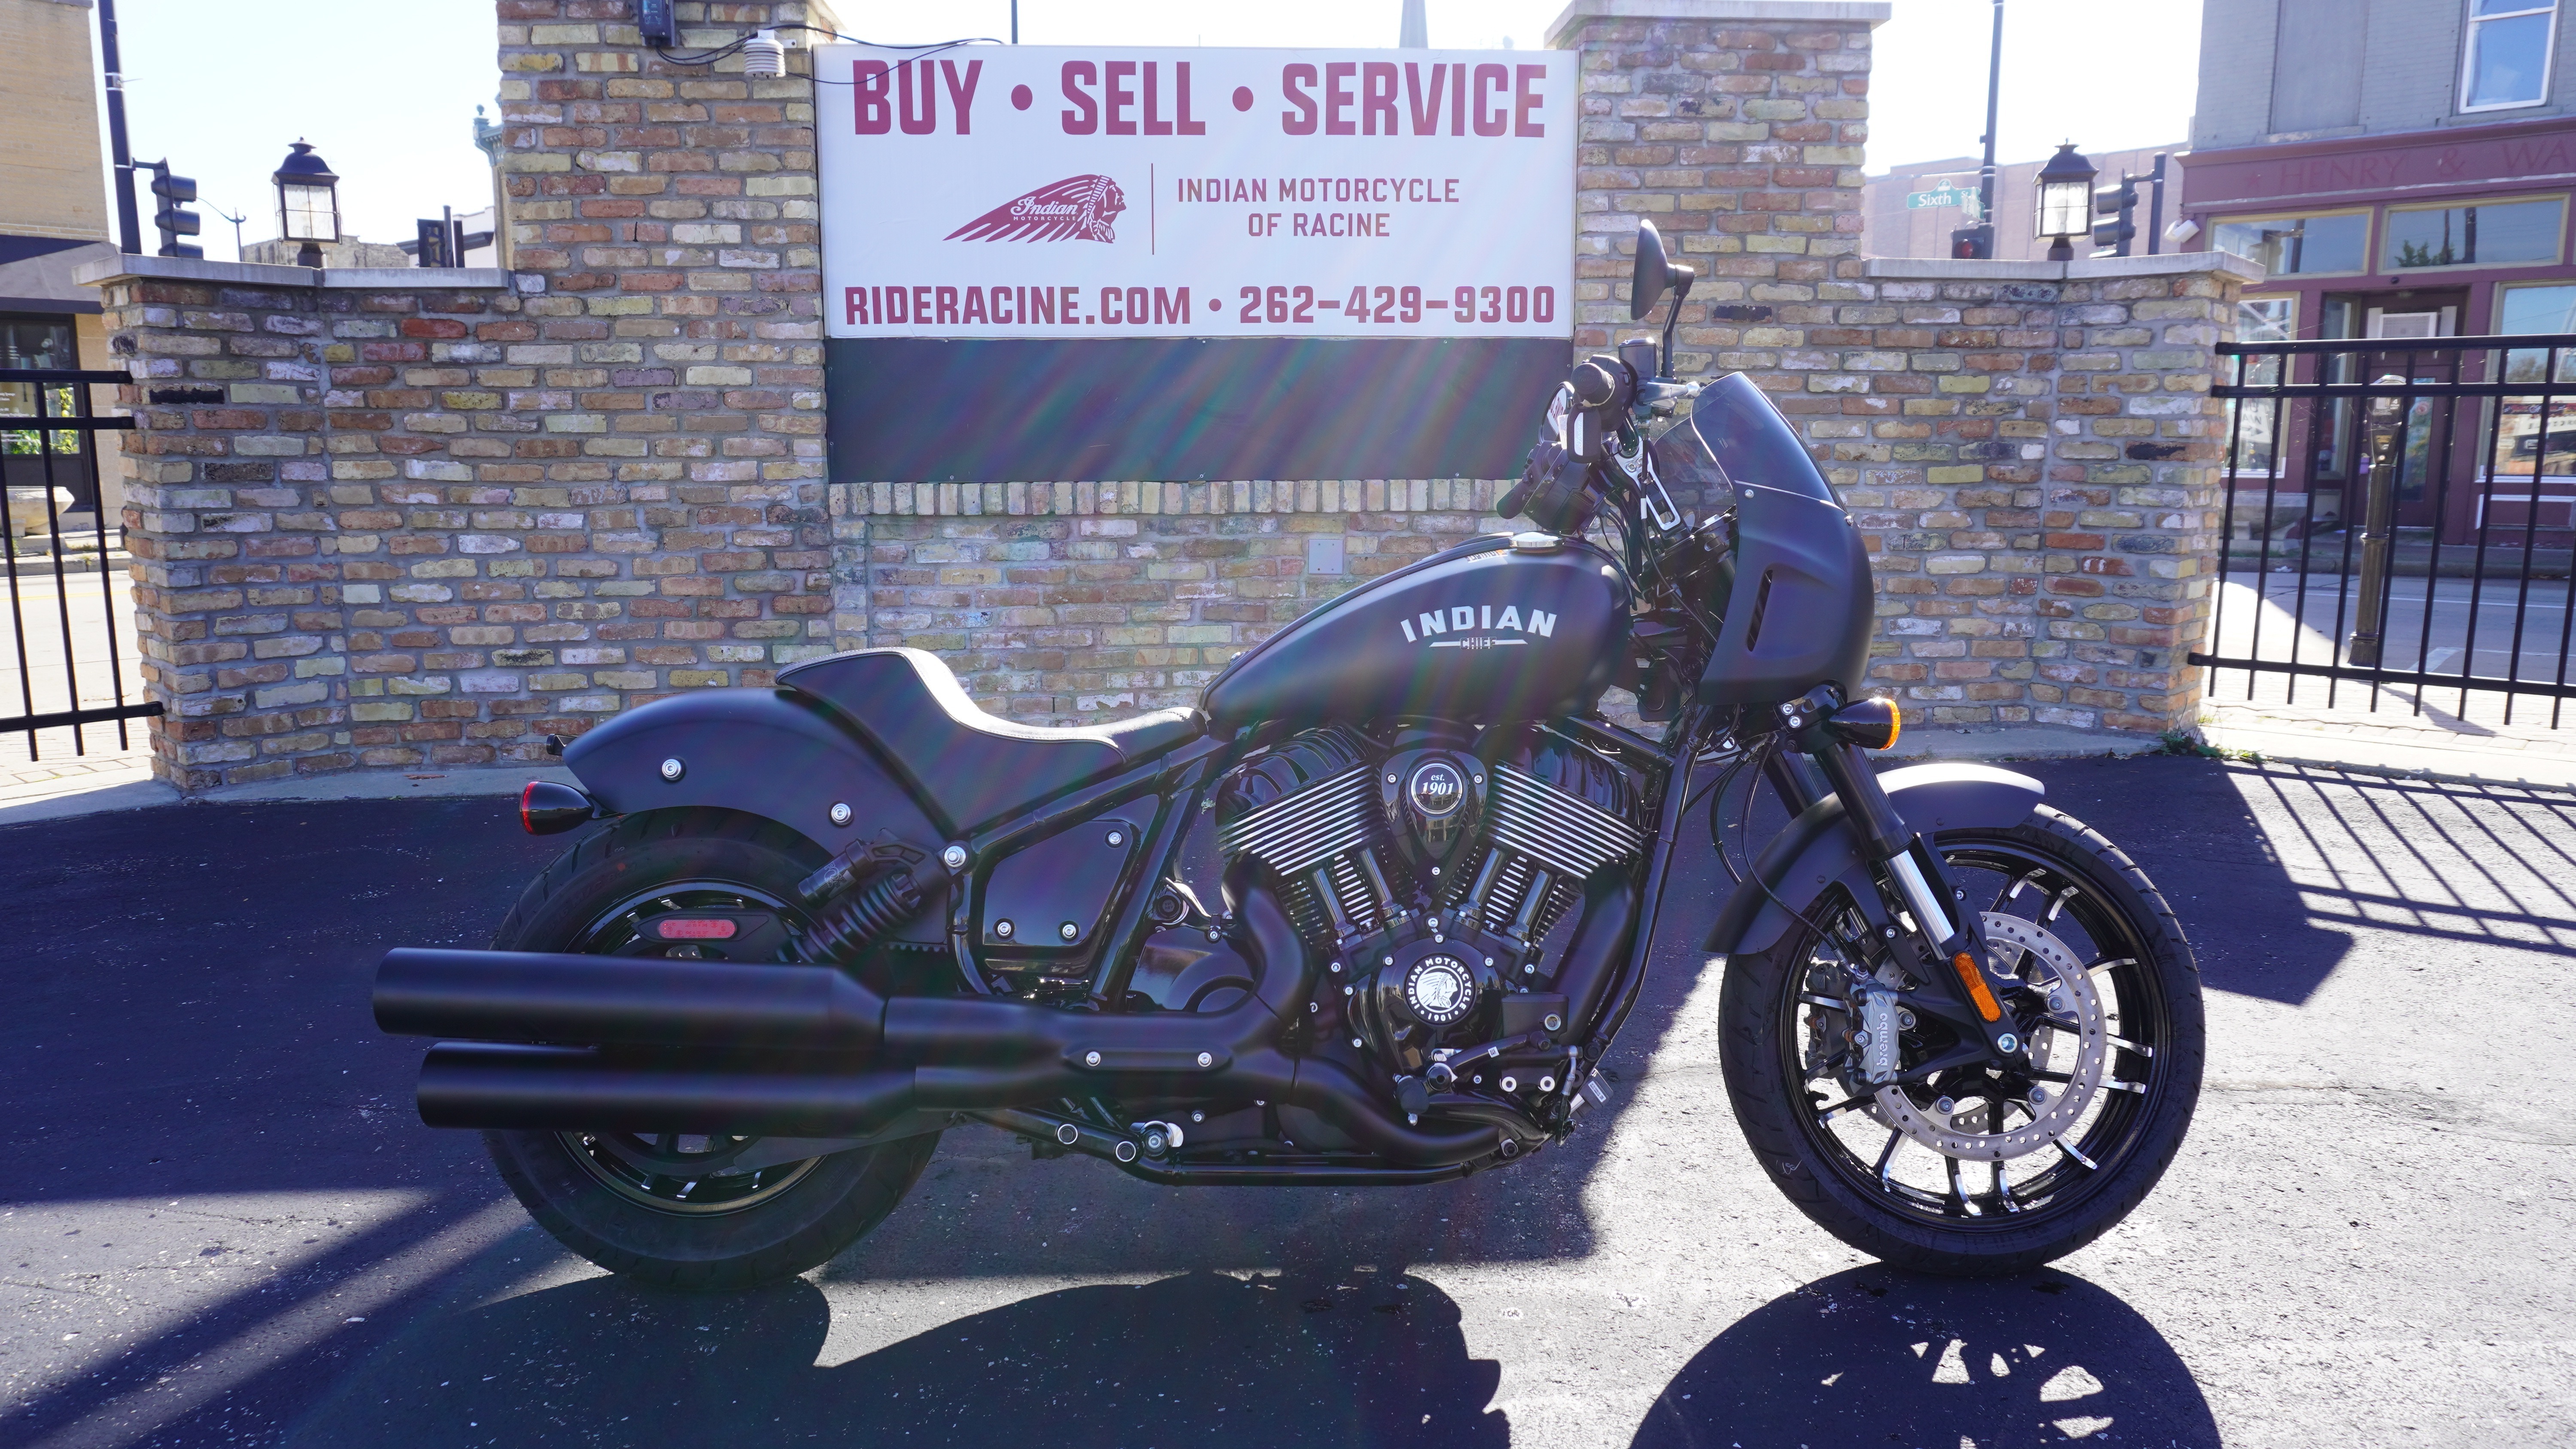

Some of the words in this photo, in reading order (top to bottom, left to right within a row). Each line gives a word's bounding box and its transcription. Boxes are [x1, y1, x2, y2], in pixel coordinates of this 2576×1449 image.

[852, 59, 983, 135] BUY
[1061, 60, 1206, 136] SELL
[1282, 62, 1546, 138] SERVICE
[2280, 155, 2404, 191] HENRY
[1178, 178, 1267, 203] INDIAN
[1279, 177, 1460, 203] MOTORCYCLE
[1918, 192, 1952, 207] Sixth
[1010, 196, 1078, 215] Indian
[1248, 213, 1282, 237] OF
[1293, 213, 1390, 237] RACINE
[844, 285, 1191, 326] RIDERACINE.COM
[1239, 285, 1555, 324] 262-429-9300
[1400, 605, 1558, 644] INDIAN
[1460, 637, 1497, 650] CHIEF
[1421, 781, 1454, 795] 1901
[1431, 773, 1445, 781] est.
[1408, 965, 1423, 1009] INDIAN
[1425, 957, 1472, 1010] MOTORCYCLE
[1428, 1012, 1452, 1022] 1901
[1876, 1012, 1888, 1066] brembo
